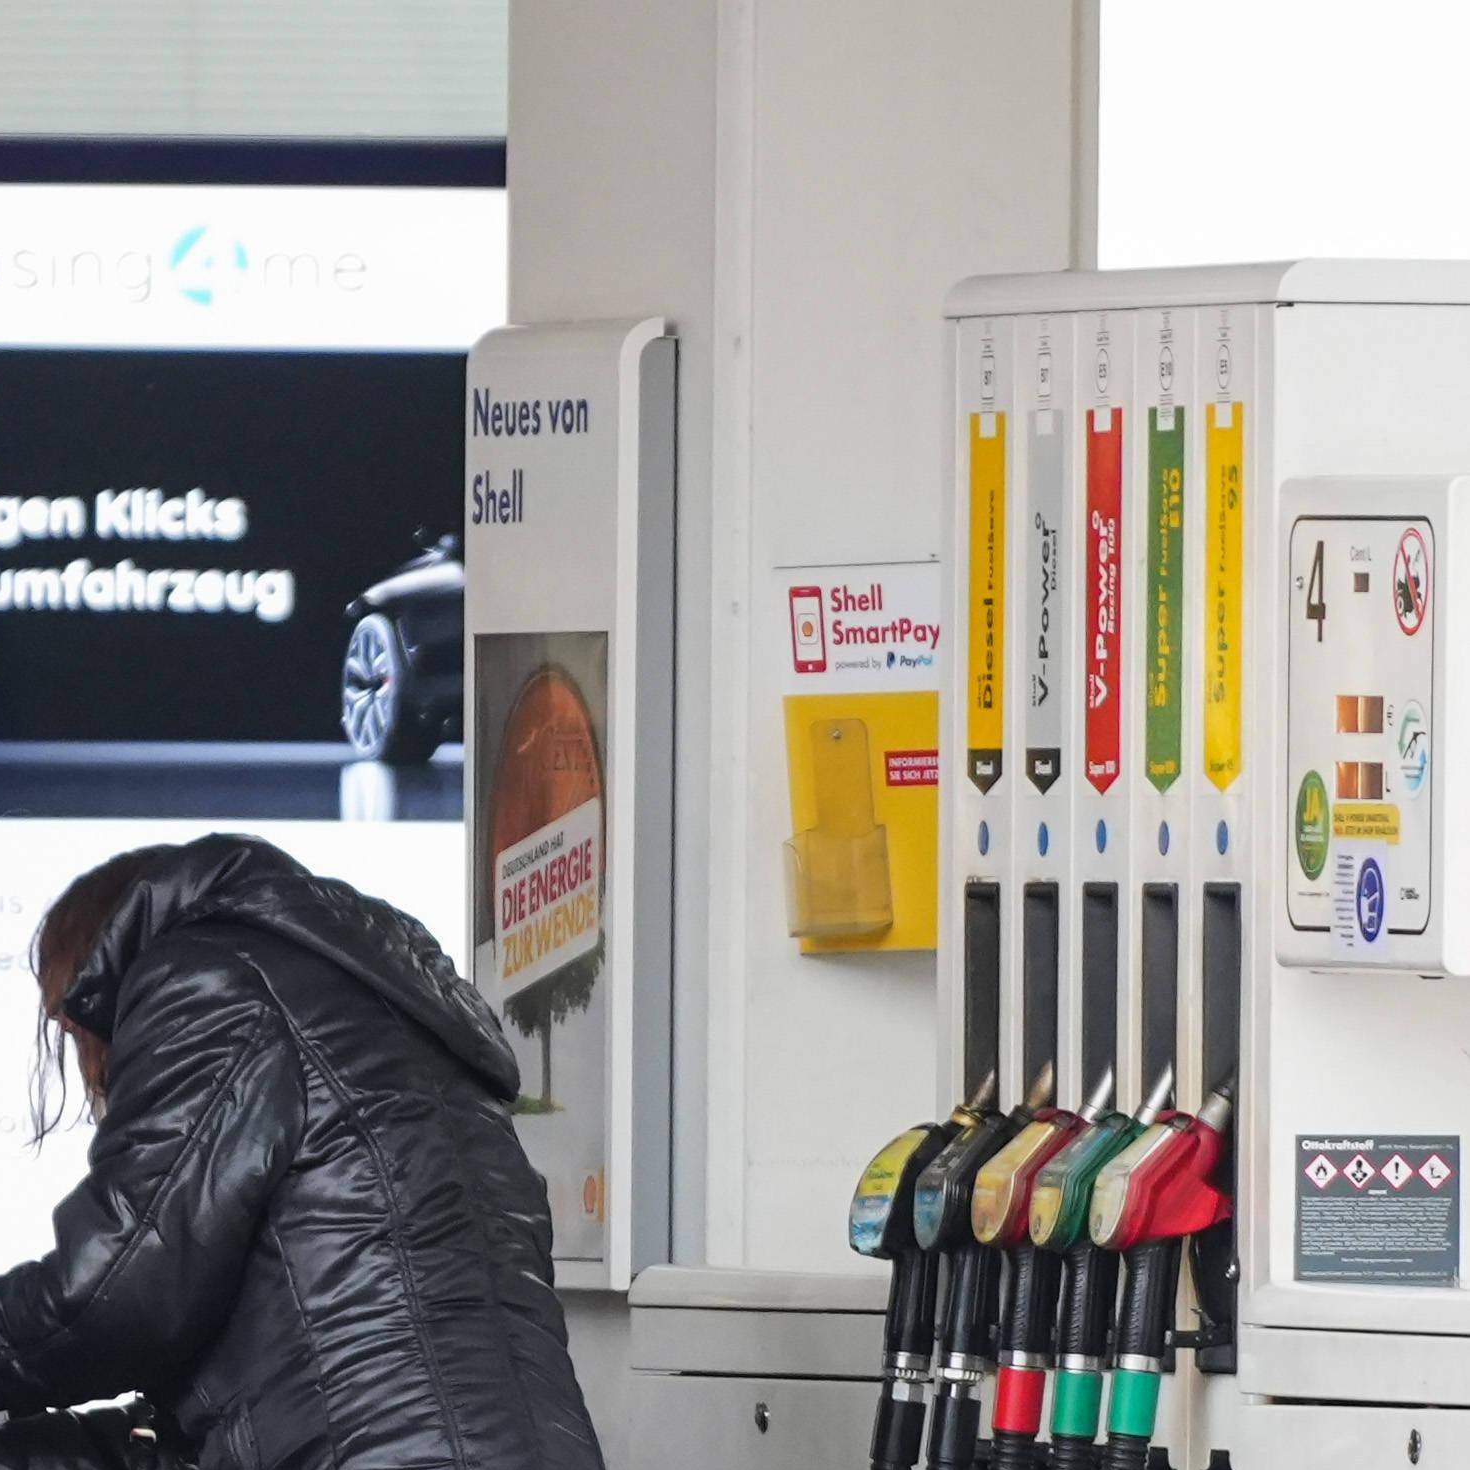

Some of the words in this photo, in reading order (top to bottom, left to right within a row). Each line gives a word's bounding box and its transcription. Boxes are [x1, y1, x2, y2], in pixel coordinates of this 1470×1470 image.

[473, 388, 541, 438] Neues
[548, 398, 588, 434] von
[94, 488, 249, 541] Klicks
[472, 468, 523, 525] Shell
[1169, 467, 1181, 528] E10
[1228, 465, 1239, 510] 95
[1107, 517, 1117, 555] 100
[830, 583, 883, 613] Shell
[1038, 519, 1050, 707] V-Power
[1095, 517, 1108, 709] V-Power
[1107, 563, 1117, 634] Racing
[1306, 540, 1327, 643] 4
[832, 617, 940, 650] SmartPay
[899, 653, 933, 668] PayPal
[983, 597, 995, 709] Diesel
[1155, 584, 1171, 707] Super
[1213, 580, 1229, 705] Super
[502, 878, 526, 931] DIE
[527, 838, 593, 917] ENERGIE
[502, 925, 532, 979] ZUR
[533, 886, 597, 961] WENDE
[1301, 1139, 1375, 1151] Ottokraftstoff
